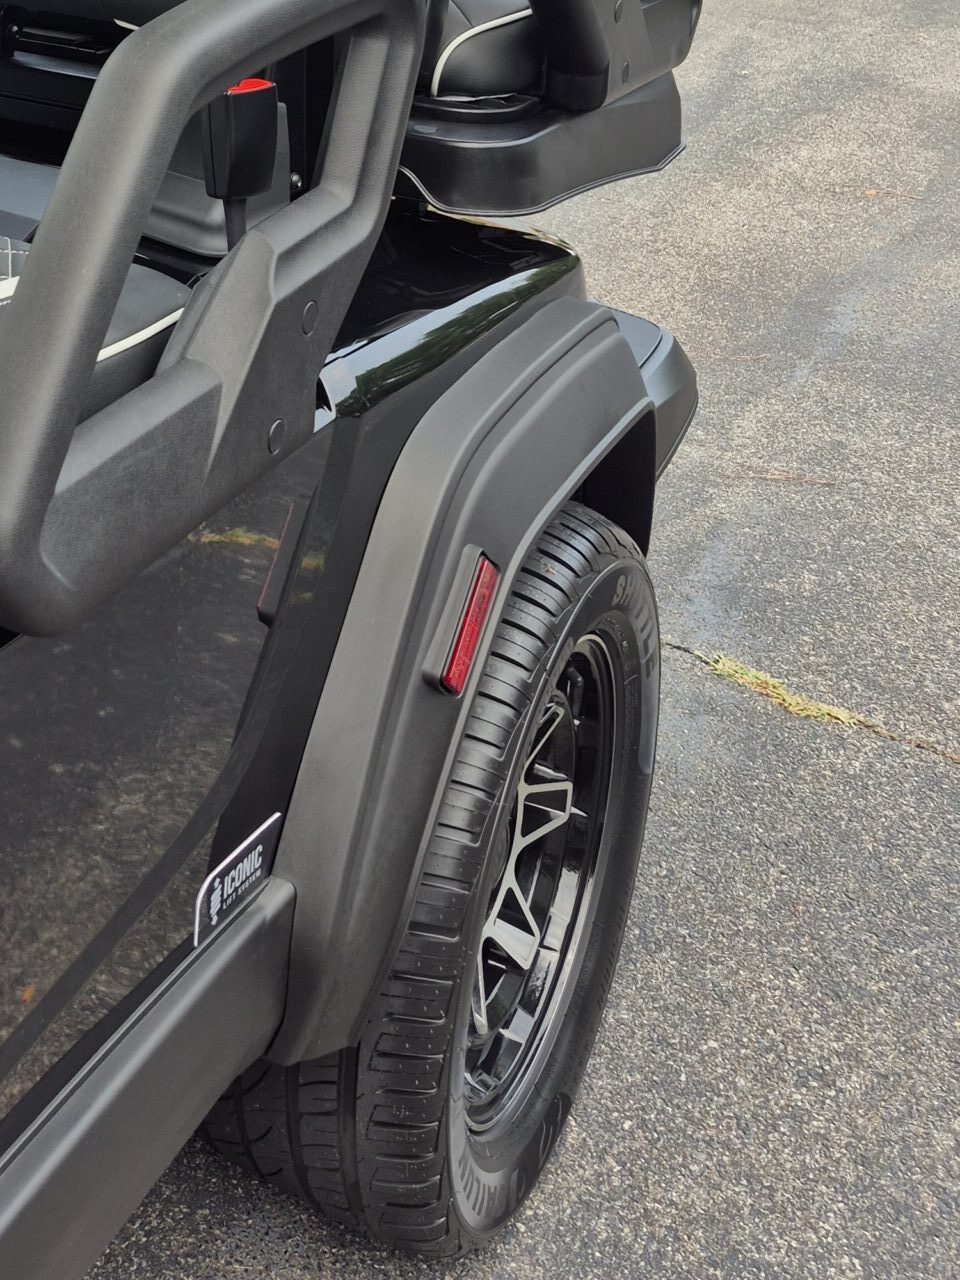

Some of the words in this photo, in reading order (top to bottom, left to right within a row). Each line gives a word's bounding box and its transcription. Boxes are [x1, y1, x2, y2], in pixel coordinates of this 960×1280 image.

[223, 844, 262, 899] ICONIC
[223, 891, 236, 909] LIFT
[238, 868, 261, 895] SYSTEM
